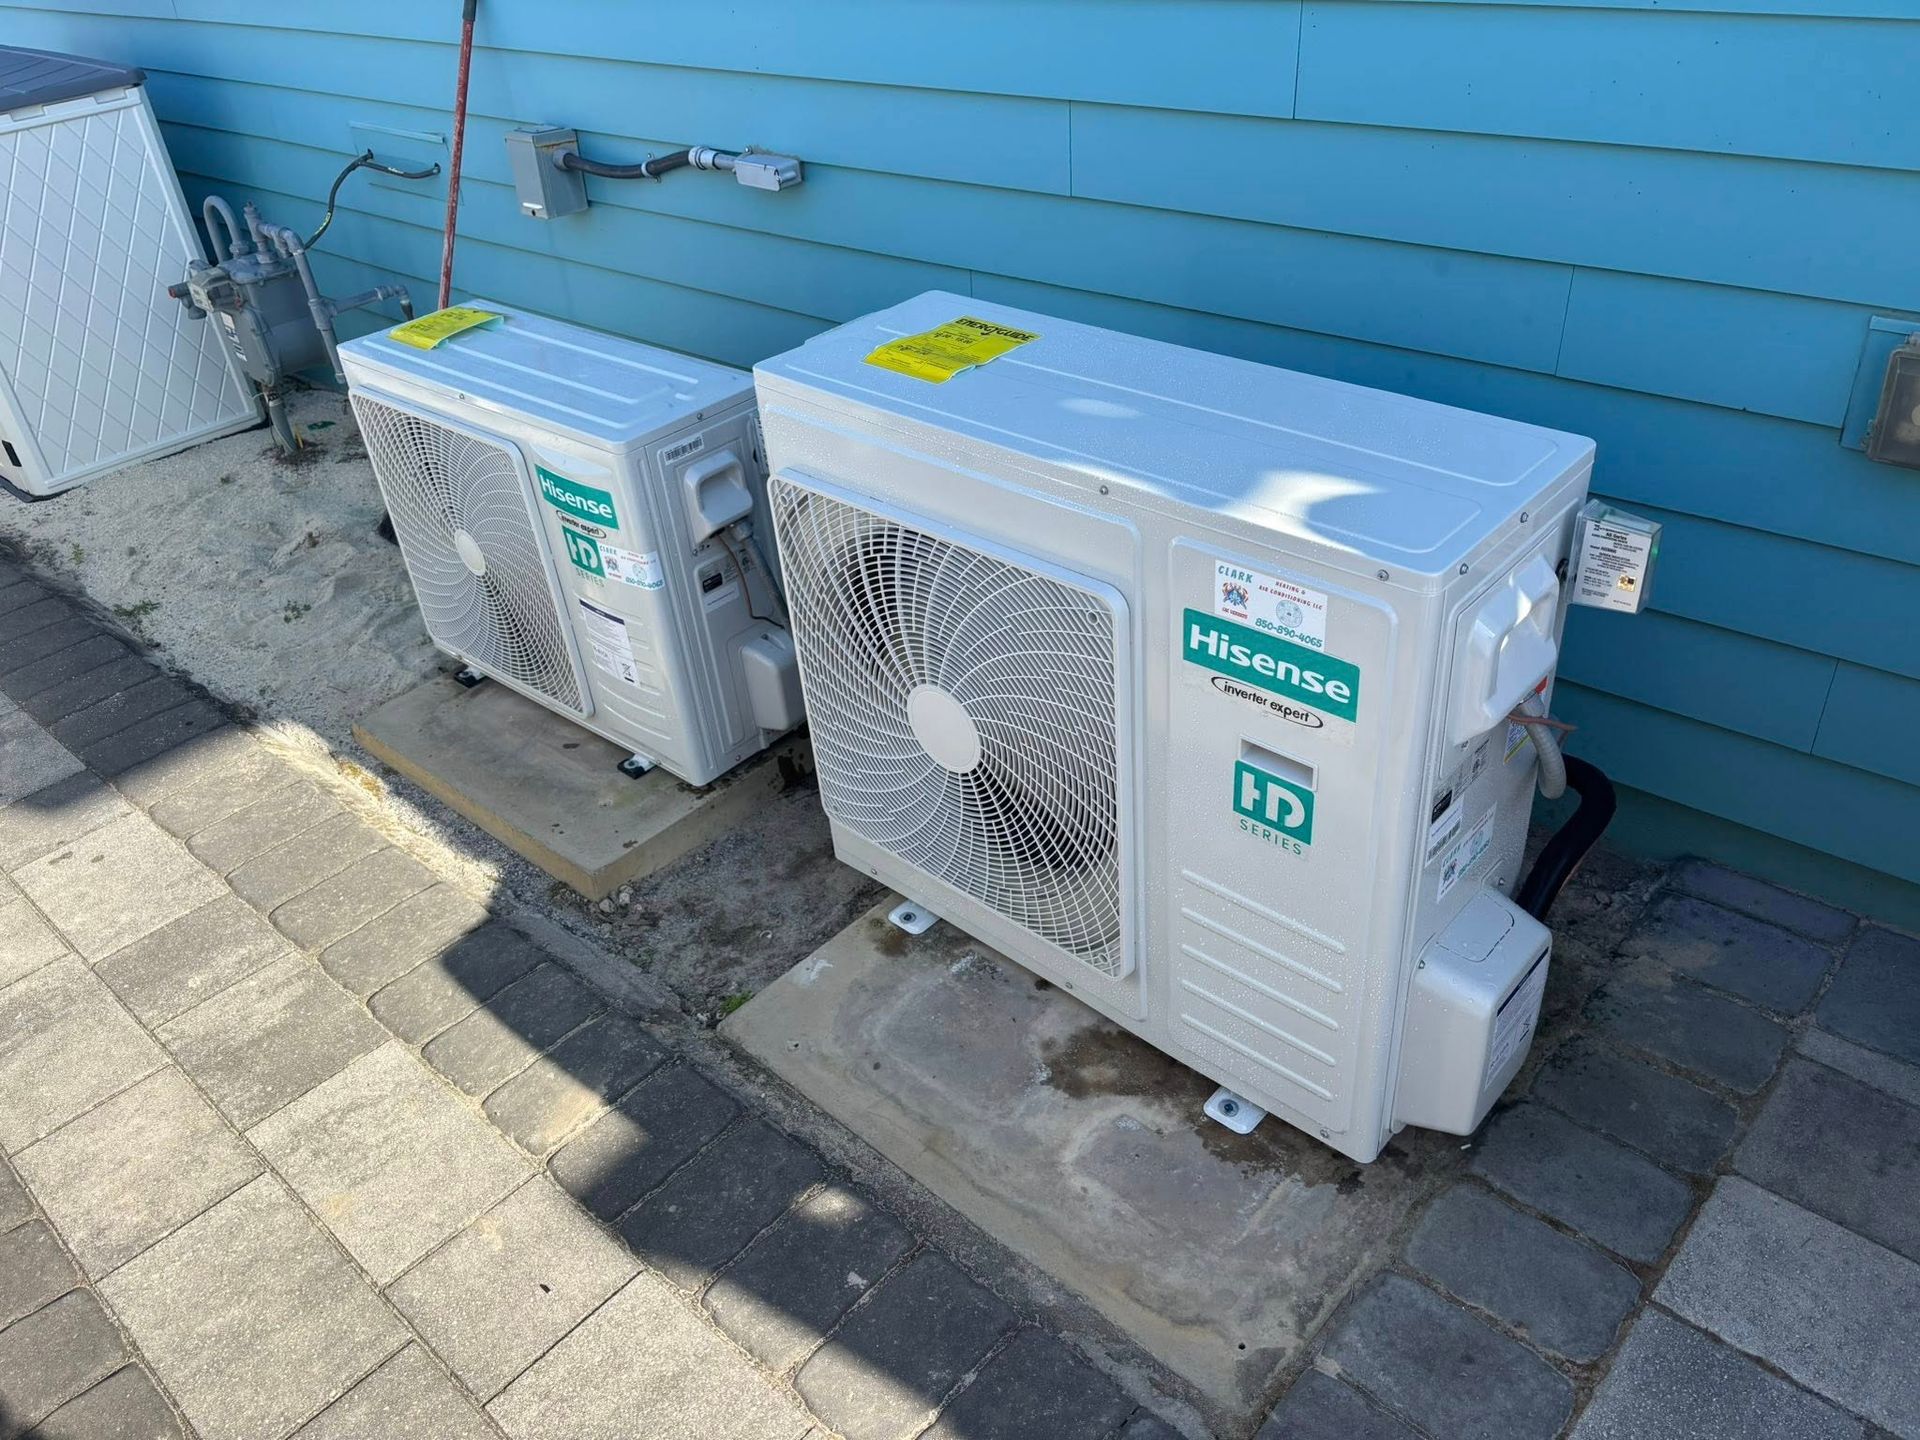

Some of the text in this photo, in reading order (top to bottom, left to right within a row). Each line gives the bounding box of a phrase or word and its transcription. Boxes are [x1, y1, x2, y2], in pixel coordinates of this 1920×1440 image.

[539, 474, 613, 519] Hisense
[575, 567, 605, 588] SERIES
[1217, 564, 1254, 584] CLARK
[1275, 580, 1299, 593] HEATING
[1254, 617, 1324, 648] 850-890-4065
[1189, 623, 1351, 705] Hisense
[1223, 680, 1310, 723] inverter expert
[1239, 818, 1303, 856] SERIES
